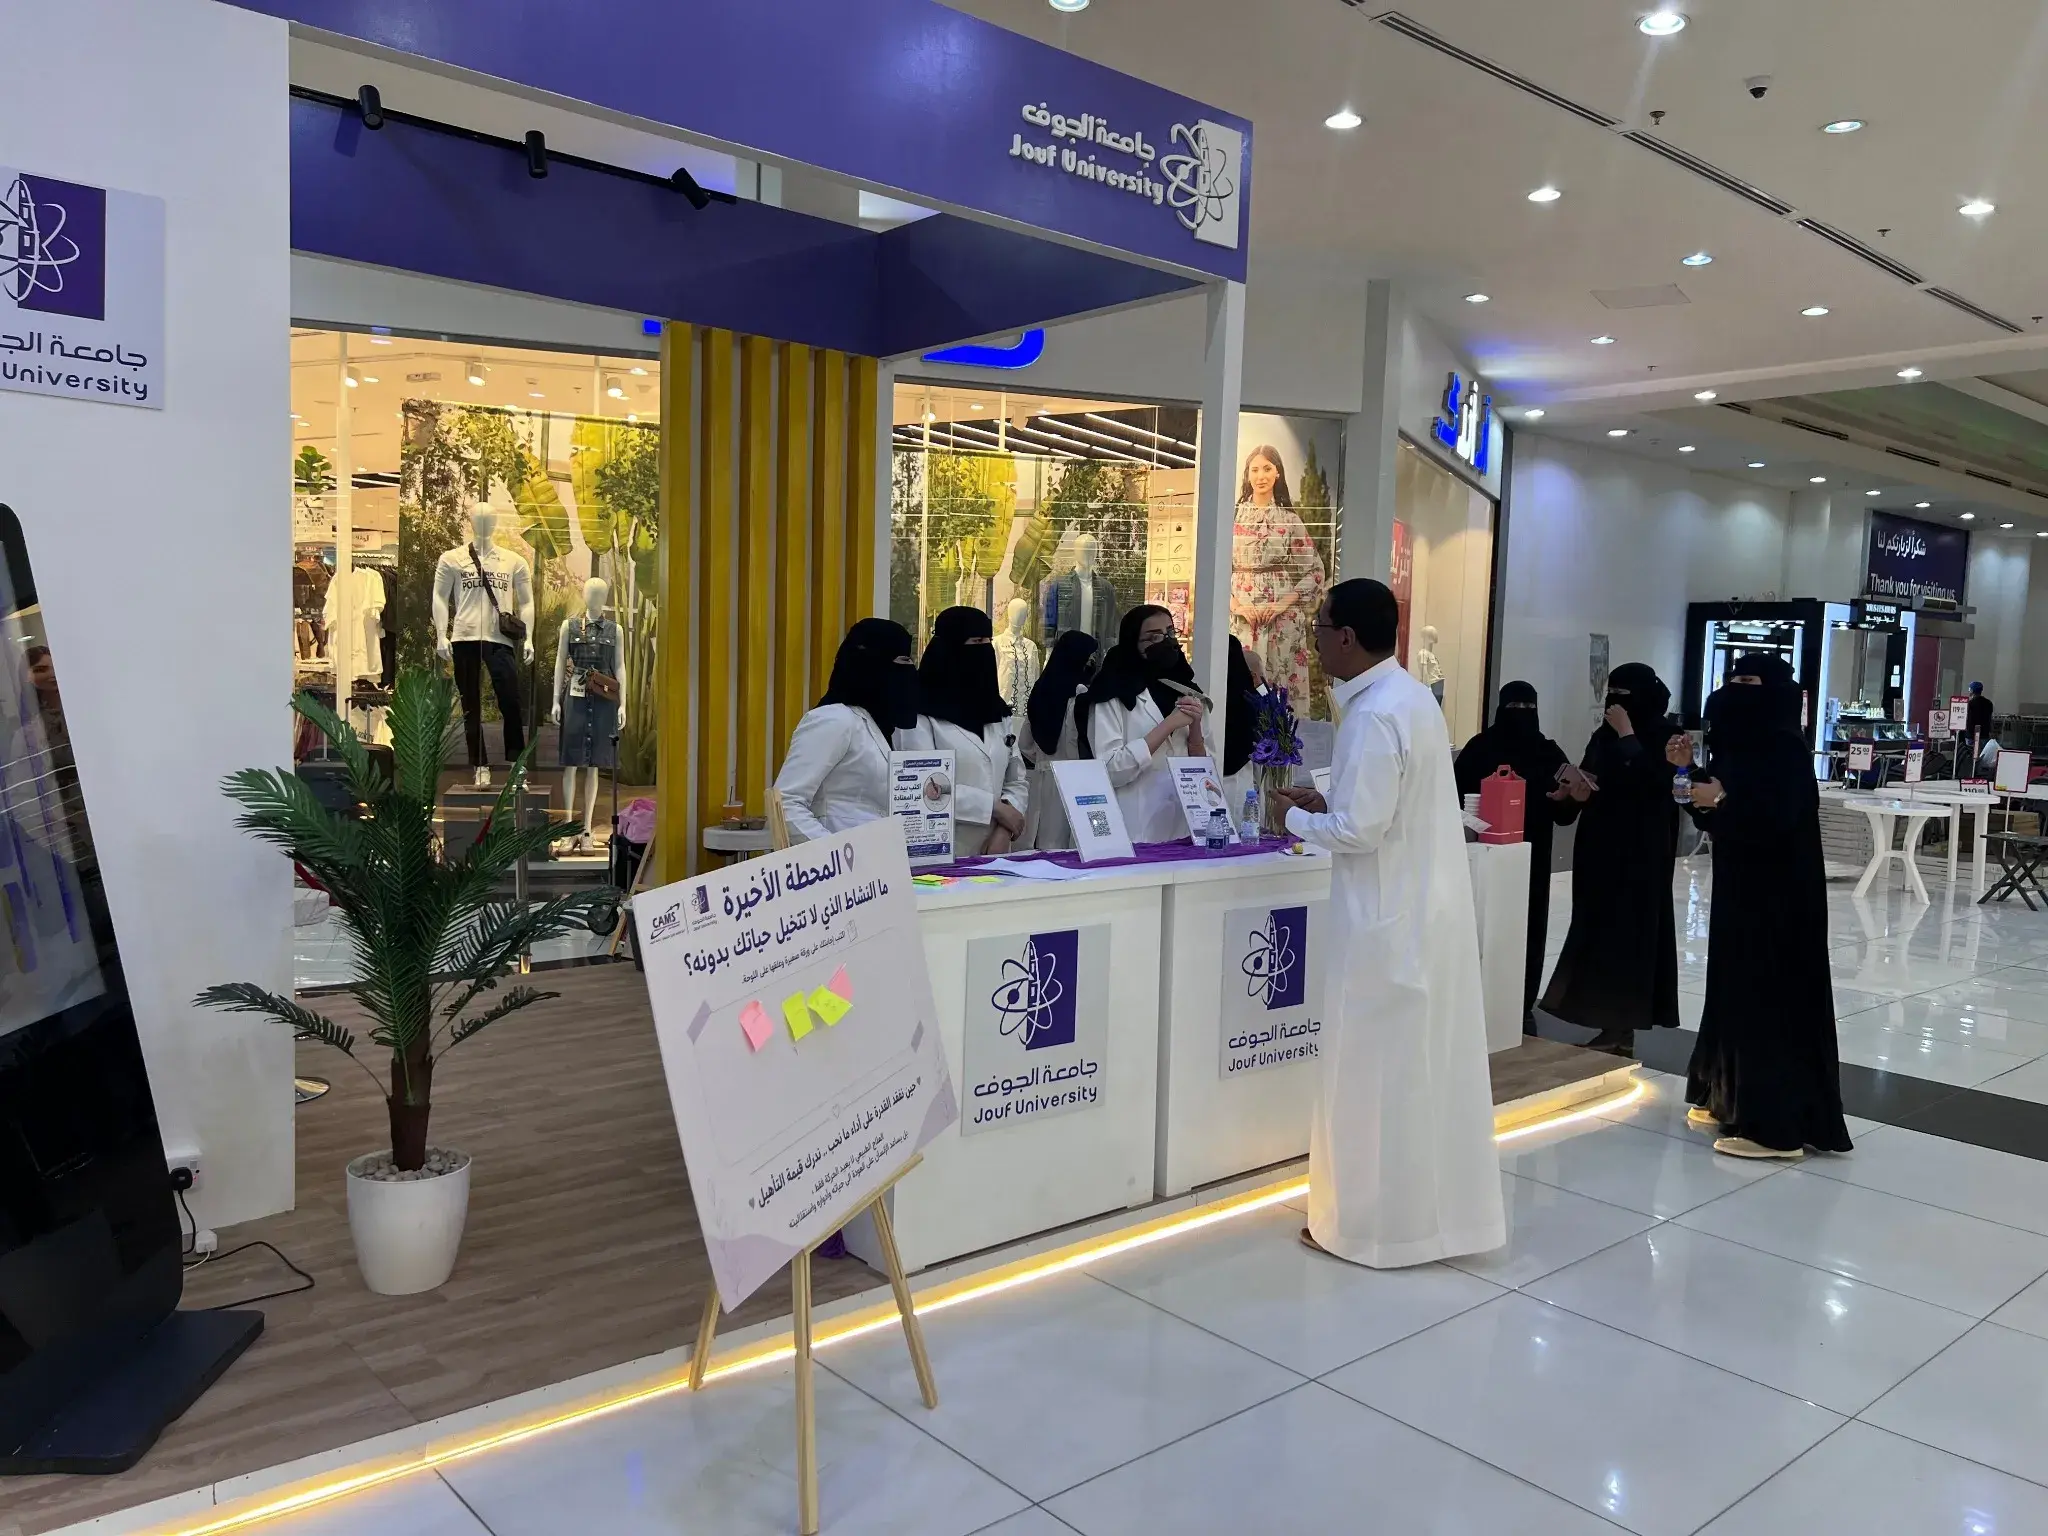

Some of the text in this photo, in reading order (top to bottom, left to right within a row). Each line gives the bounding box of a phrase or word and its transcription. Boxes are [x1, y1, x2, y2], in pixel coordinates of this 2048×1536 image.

[1022, 102, 1156, 168] جامعة الجوف
[1009, 134, 1164, 205] Jouf University
[0, 331, 147, 371] جامعة الج
[2, 361, 147, 400] University
[1877, 530, 1886, 549] لنا
[461, 571, 475, 579] NEW
[462, 580, 508, 591] POLO CLUB
[1871, 573, 1956, 601] Thank you for visiting us
[1851, 747, 1861, 755] 25
[1909, 753, 1917, 762] 90
[724, 849, 842, 921] المحطة الأخيرة
[653, 912, 676, 929] CAMS
[683, 879, 889, 976] ما النشاط الذي لا تتخيل حياتك بدونه؟
[811, 943, 819, 955] على
[760, 967, 769, 978] على
[1229, 1018, 1321, 1049] جامعة الجوف
[1229, 1054, 1256, 1072] Jouf
[974, 1058, 1098, 1097] جامعة الجوف
[892, 1088, 904, 1106] نفقد
[905, 1083, 916, 1099] حين
[875, 1097, 891, 1119] القدرة
[974, 1086, 1097, 1123] Jouf University
[851, 1114, 862, 1135] أداء
[863, 1111, 874, 1130] على
[828, 1134, 842, 1155] نحب
[842, 1128, 850, 1141] ما
[805, 1148, 822, 1170] ندرك
[787, 1159, 804, 1182] قيمة
[758, 1174, 785, 1208] التأهيل
